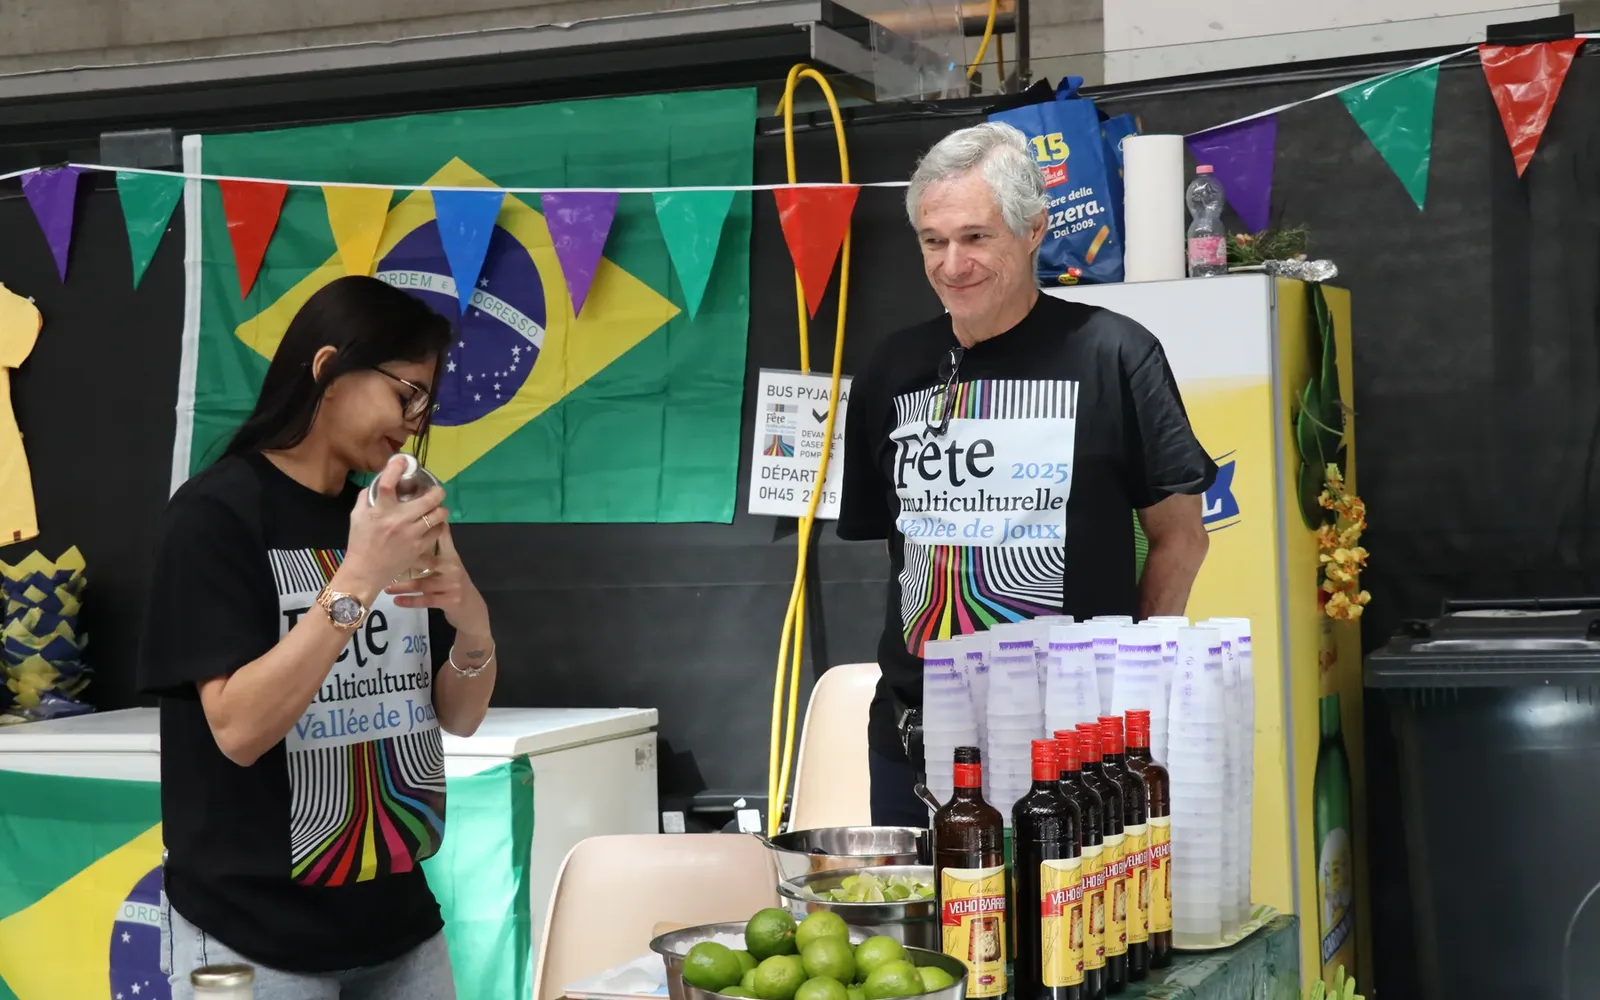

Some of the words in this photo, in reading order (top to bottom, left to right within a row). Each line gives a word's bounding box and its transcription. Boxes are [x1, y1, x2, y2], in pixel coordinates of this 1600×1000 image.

[1033, 133, 1069, 161] 15
[1047, 196, 1066, 209] cere
[1068, 187, 1093, 201] della
[1047, 200, 1105, 230] zzera.
[1053, 227, 1070, 239] Dal
[1071, 218, 1096, 233] 2009.
[472, 291, 539, 339] OGRESSO
[767, 385, 793, 398] BUS
[797, 387, 849, 403] PYJAA
[766, 412, 785, 424] Fête
[800, 440, 836, 450] CASERE
[801, 430, 830, 440] DEVAN
[800, 450, 834, 460] POMPR
[893, 428, 995, 489] Fête
[1011, 462, 1068, 485] 2025
[761, 464, 826, 484] DÉPART
[759, 486, 794, 502] 0H45
[802, 490, 837, 505] 215
[901, 488, 1063, 512] multiculturelle
[900, 517, 957, 538] Vallée
[963, 517, 994, 539] de
[1000, 517, 1060, 545] Joux
[295, 707, 369, 741] Vallée
[372, 702, 401, 730] de
[123, 903, 160, 922] ORD
[949, 900, 978, 914] VELHO
